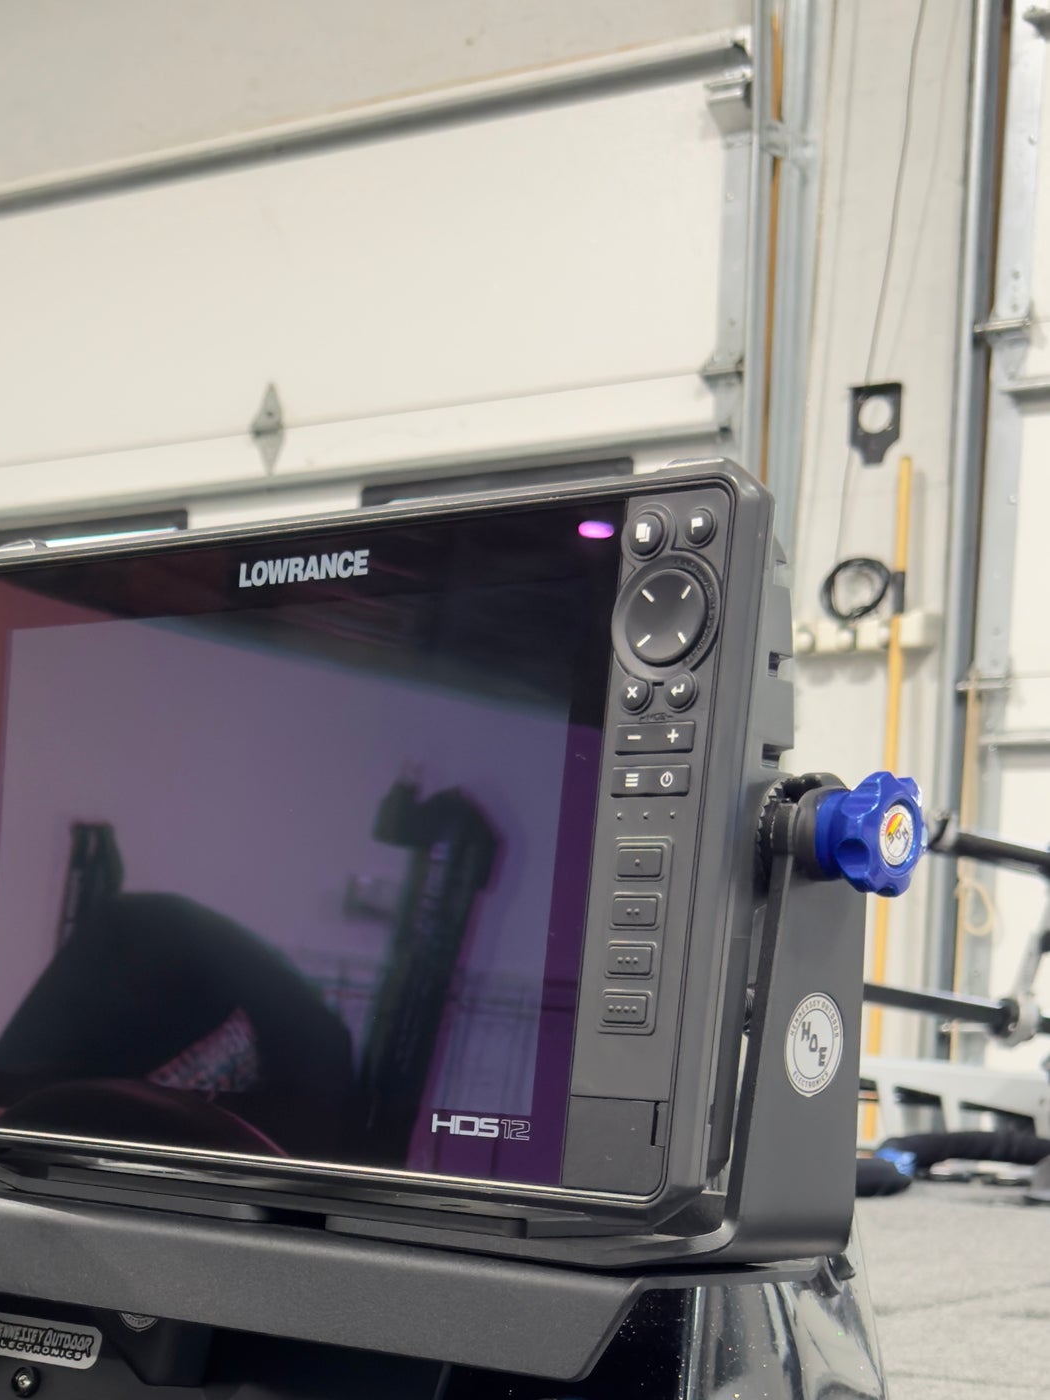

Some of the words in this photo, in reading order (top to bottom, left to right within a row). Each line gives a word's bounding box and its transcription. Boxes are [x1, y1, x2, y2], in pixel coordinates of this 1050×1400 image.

[238, 549, 370, 588] LOWRANCE
[821, 1000, 840, 1038] OUTDOOR
[43, 1328, 94, 1357] OUTDOOR
